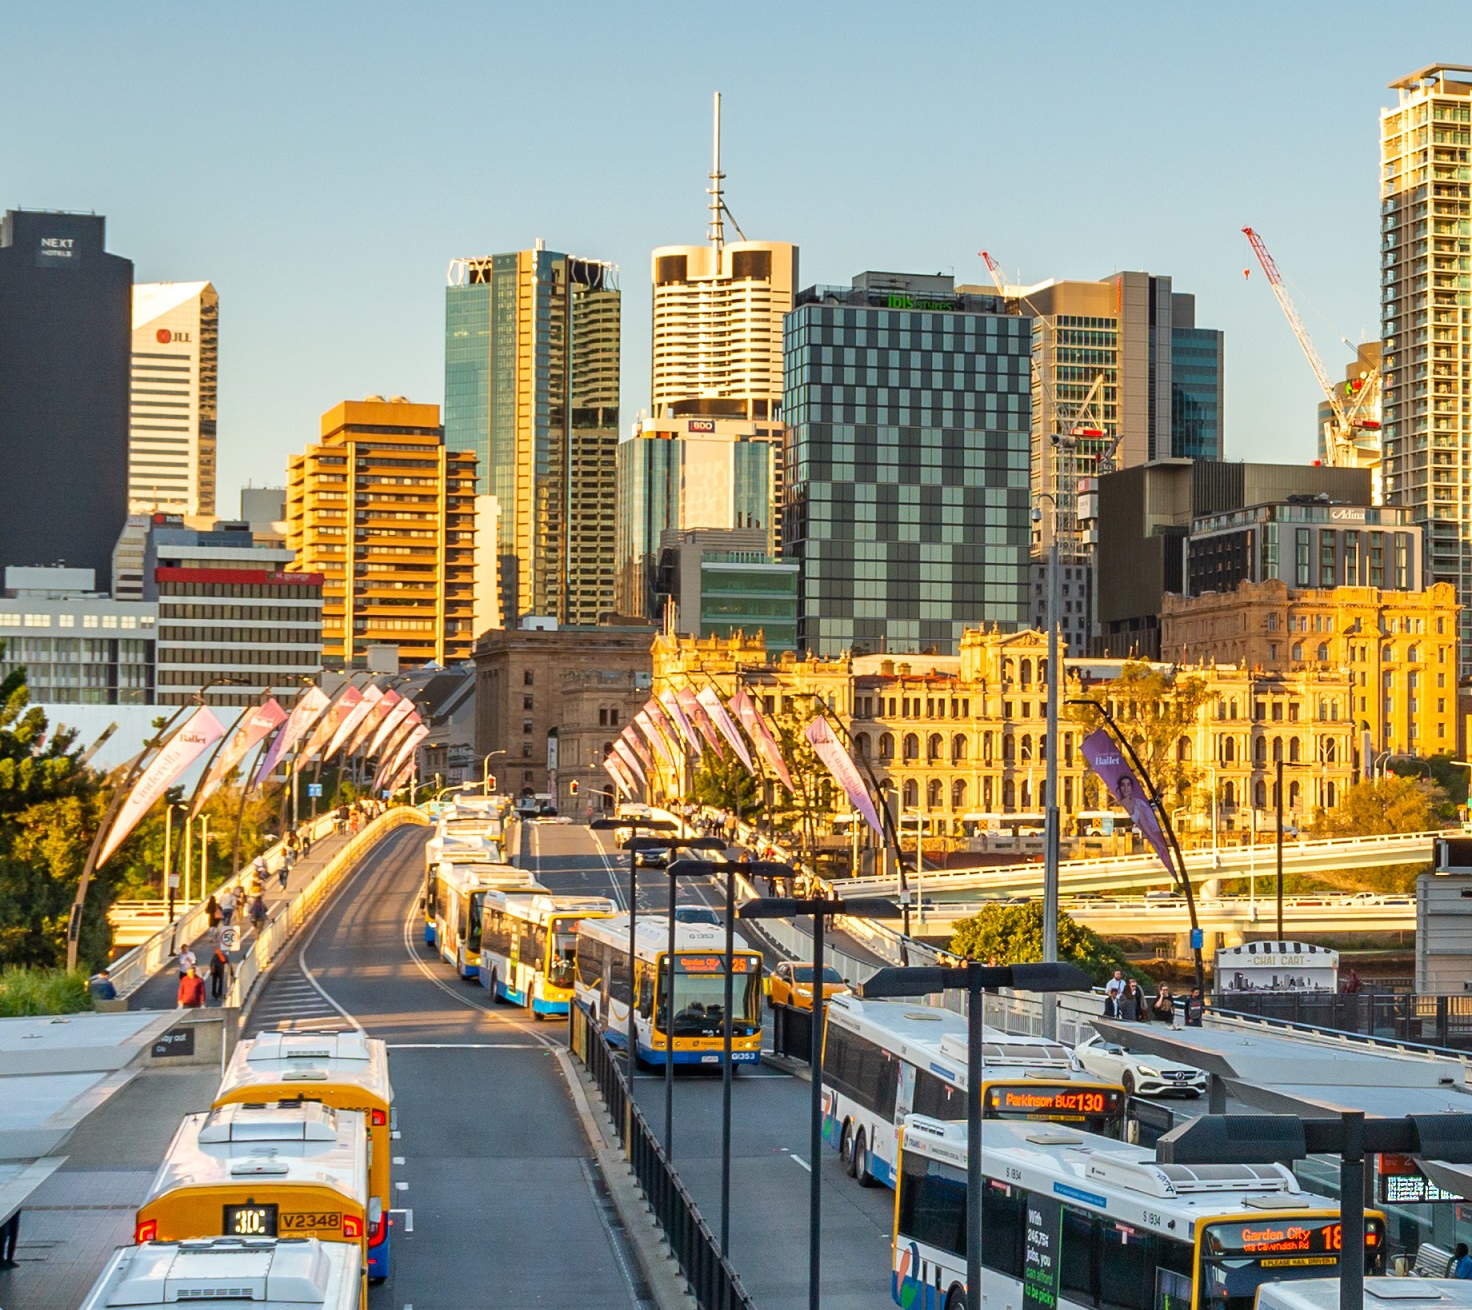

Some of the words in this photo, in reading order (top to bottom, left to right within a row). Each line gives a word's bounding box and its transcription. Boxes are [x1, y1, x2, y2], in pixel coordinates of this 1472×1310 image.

[41, 238, 74, 248] NEXT
[887, 293, 914, 310] ibis
[171, 332, 192, 343] JLL
[692, 422, 713, 432] BDO
[166, 514, 183, 523] nab
[1332, 510, 1365, 520] Adina
[180, 734, 206, 744] Ballet
[1095, 756, 1120, 765] Ballet
[133, 751, 182, 805] Cinderella
[224, 933, 237, 943] 50
[1253, 956, 1276, 965] CHAI
[1281, 956, 1304, 965] CART
[1006, 1092, 1053, 1108] Parkinson
[1055, 1094, 1077, 1108] BUZ
[1077, 1093, 1104, 1111] 130
[283, 1215, 339, 1227] V2348
[1242, 1228, 1284, 1241] Garden
[1286, 1226, 1311, 1243] City
[1243, 1243, 1255, 1252] via
[1257, 1241, 1297, 1251] Cavendish
[1299, 1240, 1310, 1250] Rd
